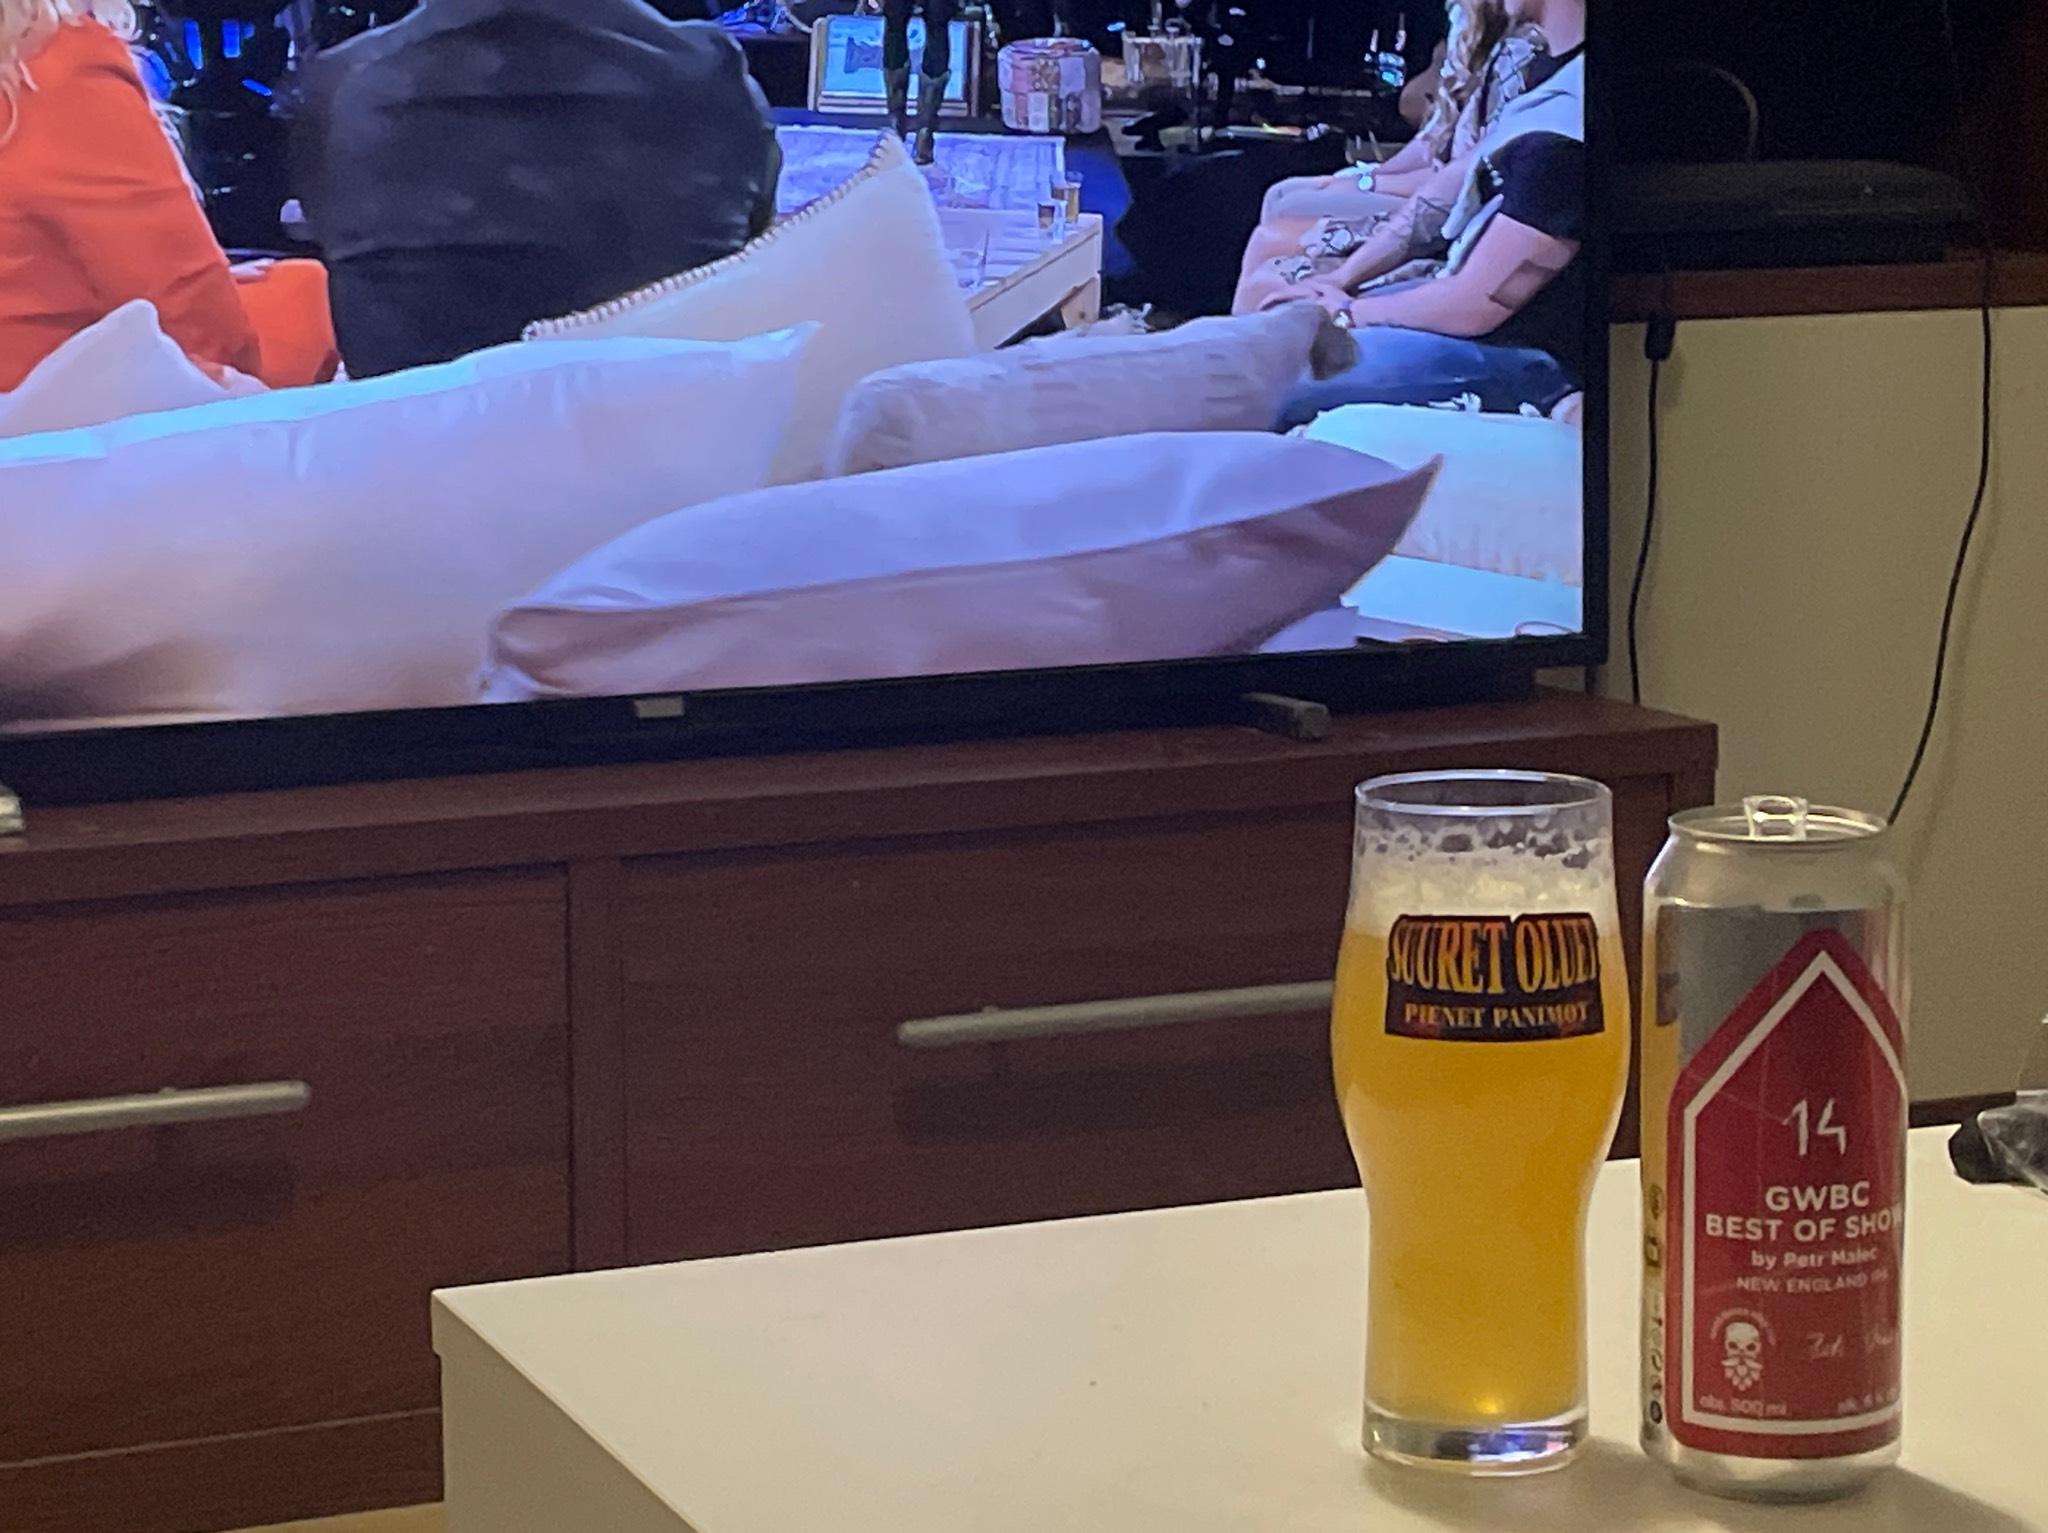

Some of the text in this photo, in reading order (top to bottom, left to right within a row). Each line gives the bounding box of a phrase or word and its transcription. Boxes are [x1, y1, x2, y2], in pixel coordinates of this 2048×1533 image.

[1404, 1001, 1588, 1029] PIENET PANIMOT
[1782, 1098, 1847, 1156] 14
[1765, 1181, 1870, 1212] GWBC
[1706, 1213, 1783, 1241] BEST
[1794, 1219, 1836, 1242] OF
[1751, 1250, 1777, 1270] by
[1784, 1251, 1824, 1268] Petr
[1736, 1276, 1779, 1292] NEW
[1786, 1272, 1867, 1293] ENGLAND
